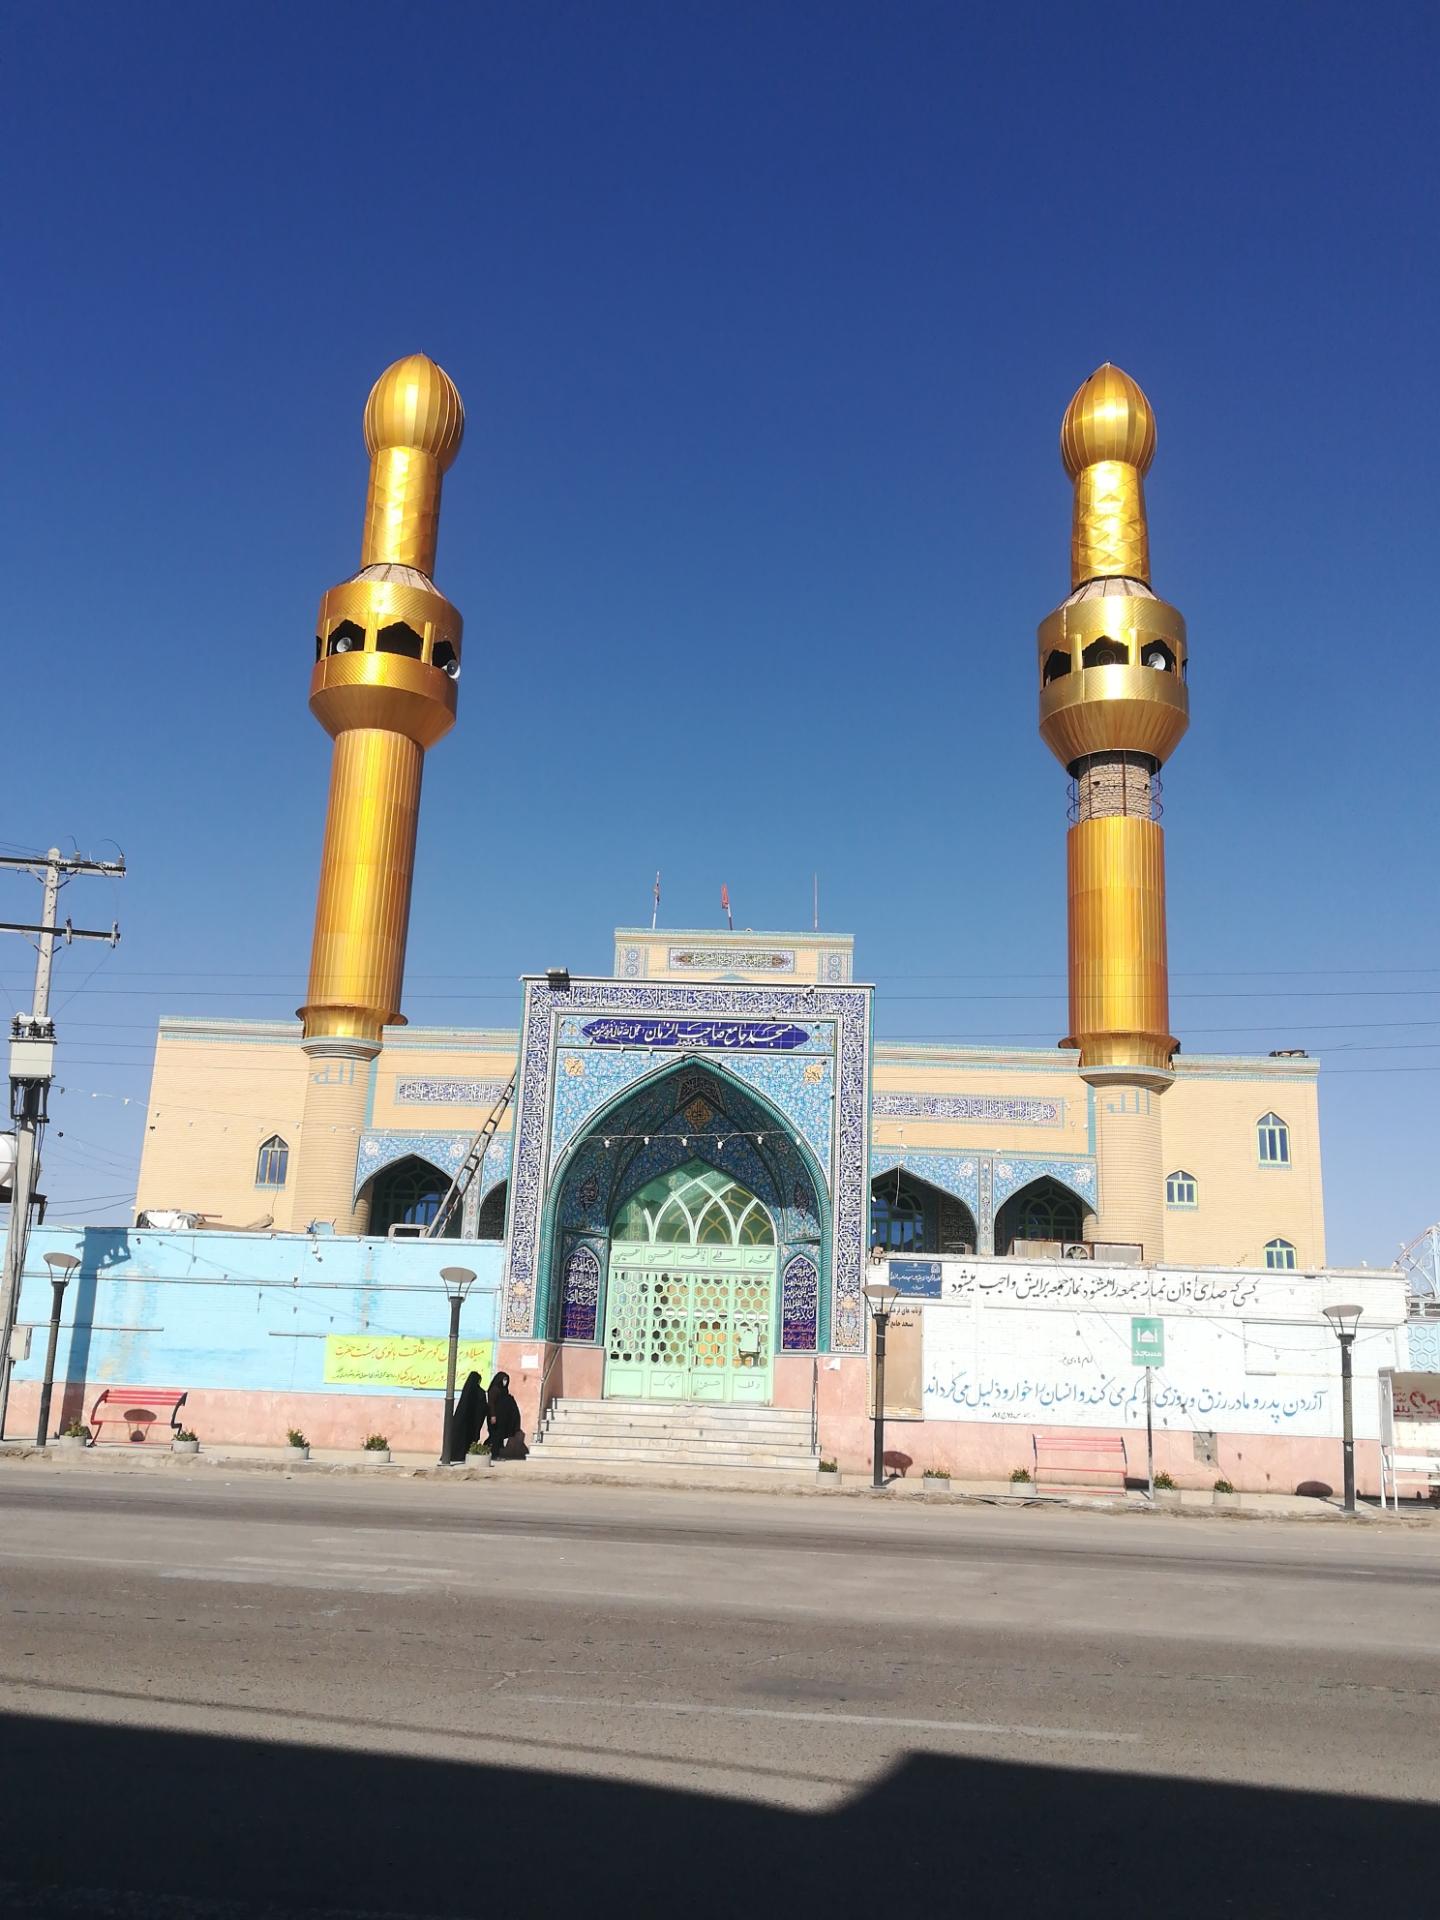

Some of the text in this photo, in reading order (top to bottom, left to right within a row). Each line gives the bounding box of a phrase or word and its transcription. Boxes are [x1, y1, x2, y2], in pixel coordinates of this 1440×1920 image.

[645, 1020, 679, 1042] الزمان
[677, 1021, 724, 1040] صاحب
[724, 1022, 749, 1046] جامع
[749, 1023, 793, 1047] مسجد
[313, 1059, 355, 1086] الله
[1106, 1088, 1151, 1116] الله
[614, 1248, 641, 1262] حسین
[648, 1248, 674, 1264] حسن
[979, 1273, 1017, 1296] واجب
[1016, 1272, 1050, 1300] برایش
[1049, 1278, 1068, 1296] جمعه
[1063, 1277, 1084, 1297] نماز
[1083, 1277, 1112, 1300] بشنود
[1117, 1280, 1141, 1300] جمعه
[1141, 1276, 1167, 1297] نماز
[1230, 1276, 1246, 1293] که
[1232, 1277, 1262, 1307] کسی
[1135, 1350, 1162, 1361] مسجد
[923, 1370, 967, 1399] گرداند
[952, 1384, 971, 1404] می
[966, 1378, 1001, 1408] ذلیل
[1008, 1379, 1033, 1402] خوار
[1039, 1382, 1077, 1407] انسان
[1087, 1376, 1117, 1404] کند
[1079, 1390, 1086, 1403] و
[1108, 1386, 1127, 1407] می
[1154, 1386, 1188, 1408] روزی
[1189, 1397, 1196, 1408] و
[1198, 1387, 1229, 1413] رزق
[1229, 1391, 1251, 1411] مادر
[1253, 1397, 1260, 1409] و
[1283, 1389, 1329, 1417] آزردن
[1261, 1397, 1280, 1424] پدر
